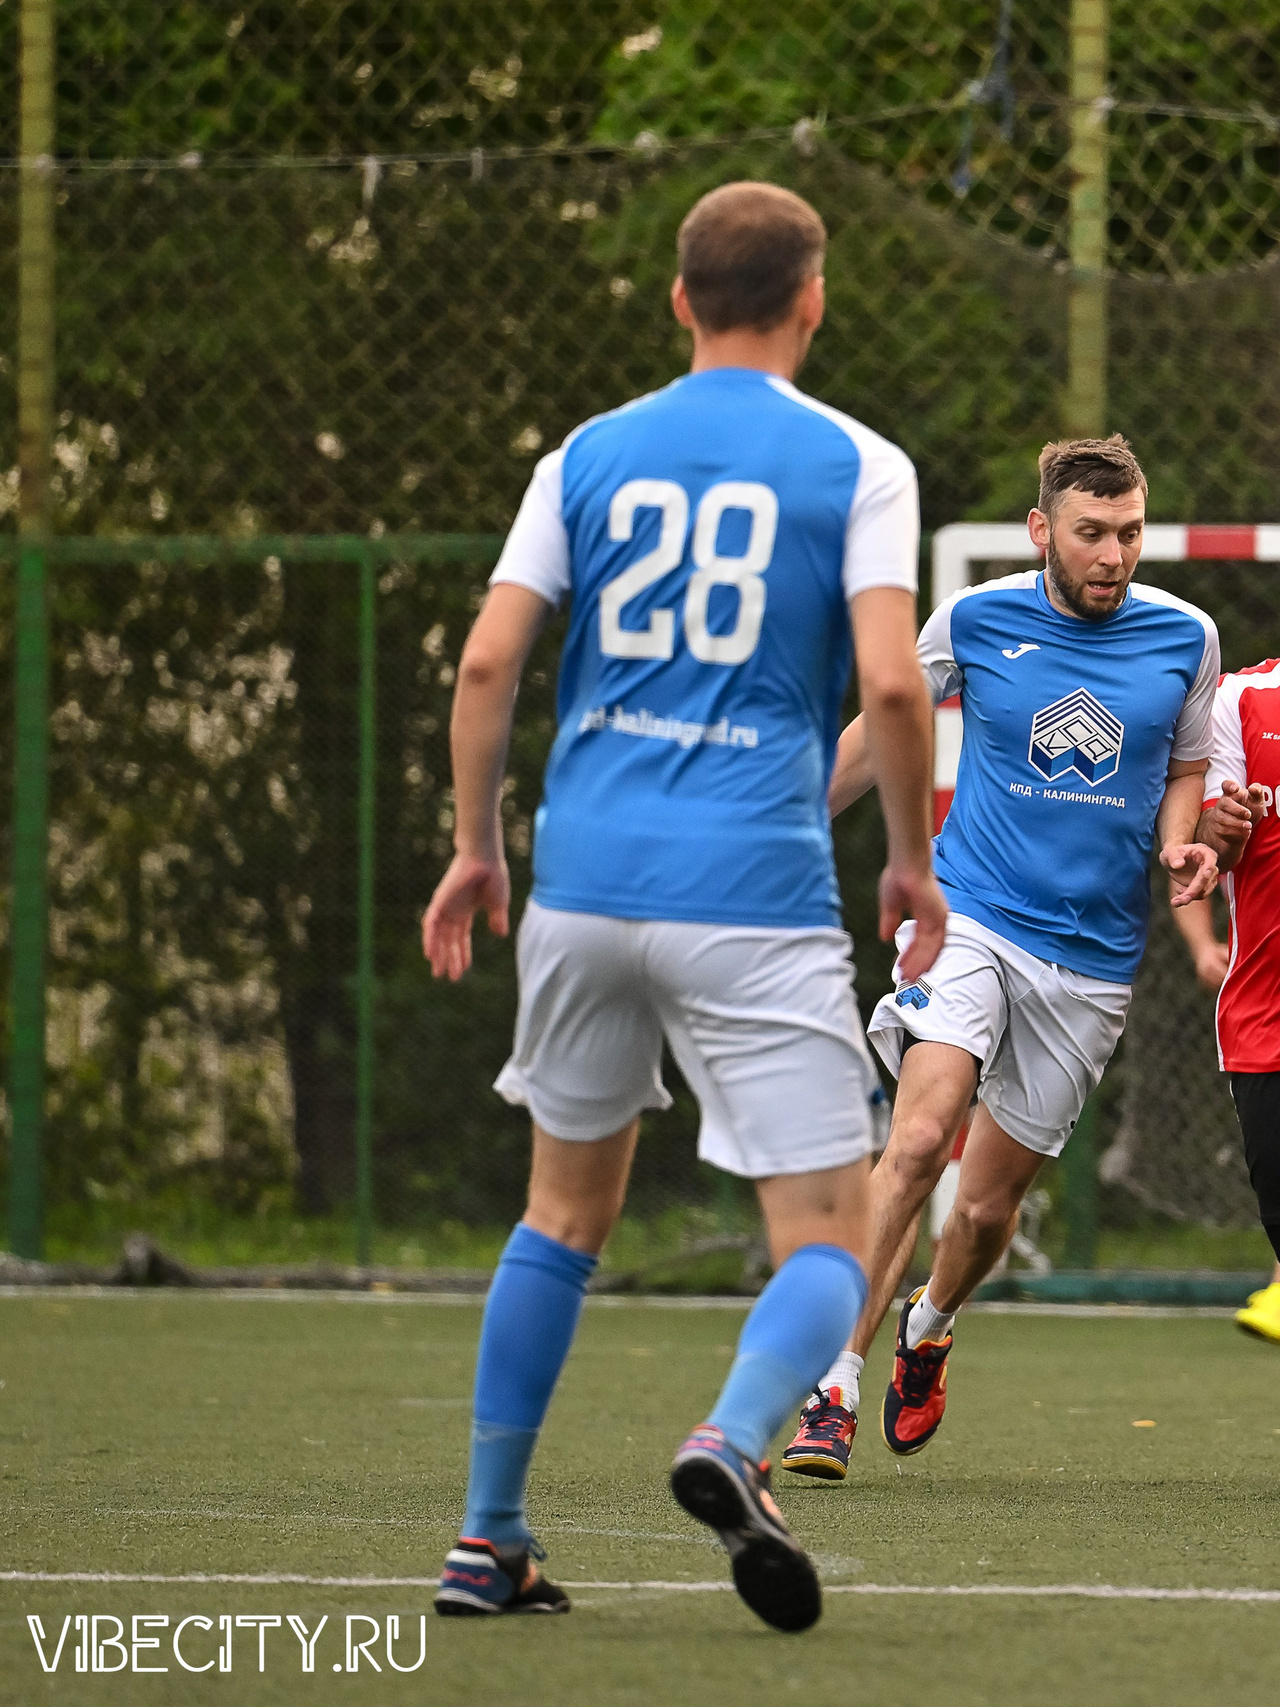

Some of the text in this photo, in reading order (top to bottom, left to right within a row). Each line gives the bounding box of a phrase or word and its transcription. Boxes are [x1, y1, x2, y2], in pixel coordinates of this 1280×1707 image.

[599, 478, 779, 666] 28
[1009, 782, 1032, 797] КПД
[1043, 789, 1126, 808] КАЛИНИНГРАД
